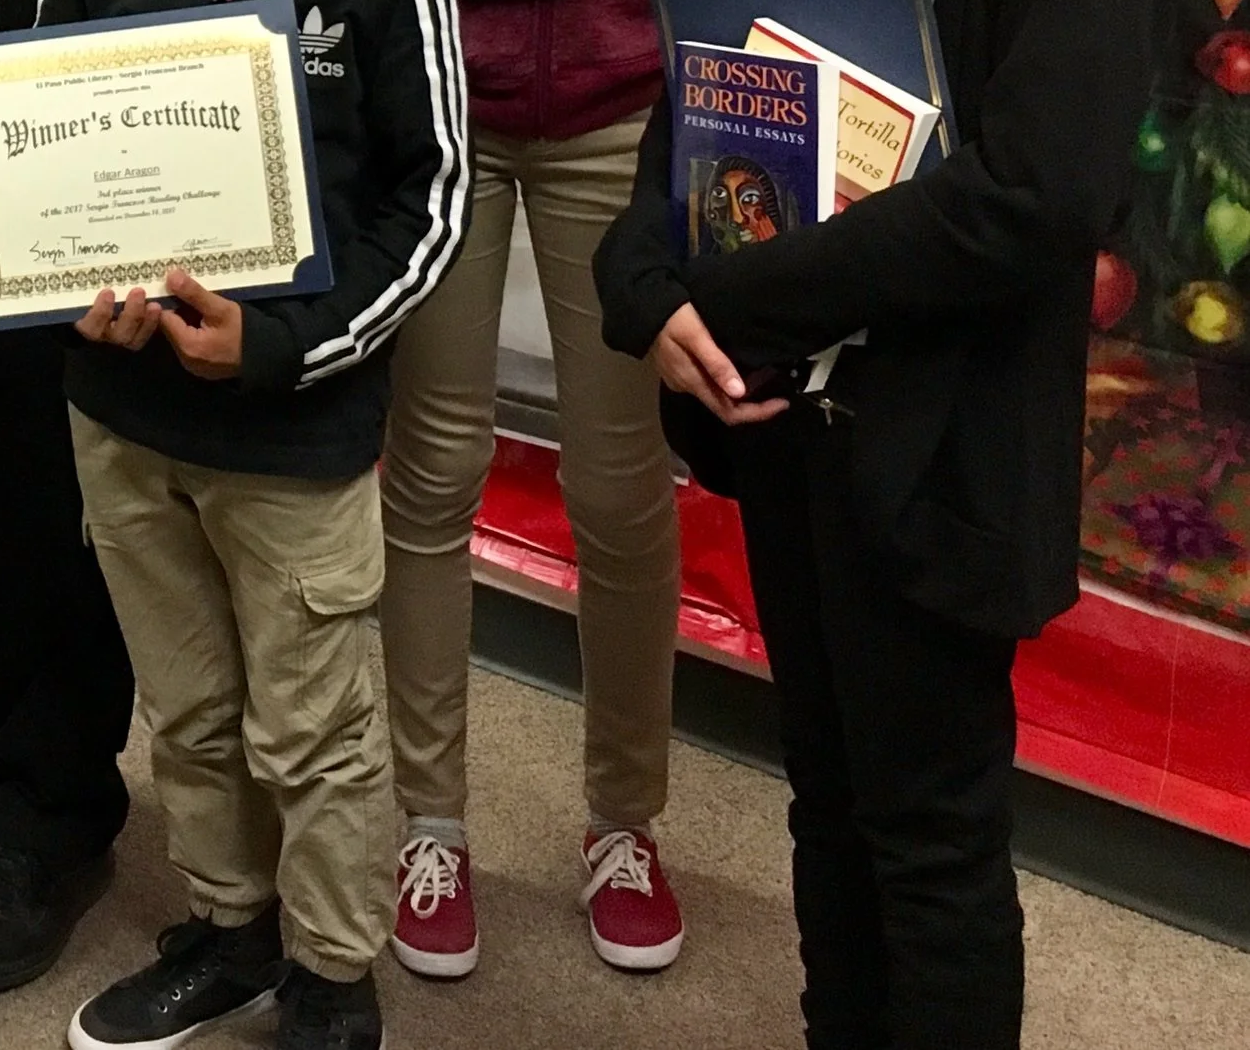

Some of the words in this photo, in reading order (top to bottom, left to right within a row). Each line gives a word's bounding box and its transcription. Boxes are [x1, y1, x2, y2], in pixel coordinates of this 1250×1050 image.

[301, 56, 345, 78] idas
[684, 55, 807, 95] CROSSING
[684, 82, 808, 126] BORDERS
[838, 97, 900, 151] Tortilla
[0, 111, 112, 160] Winner's
[121, 99, 242, 132] Certificate
[684, 114, 749, 136] PERSONAL
[755, 127, 806, 145] ESSAYS
[94, 170, 121, 182] Edgar
[124, 165, 161, 179] Aragon
[837, 140, 884, 180] ories
[40, 207, 49, 218] of
[50, 206, 62, 216] the
[64, 204, 83, 214] 2017
[182, 189, 221, 200] Challenge
